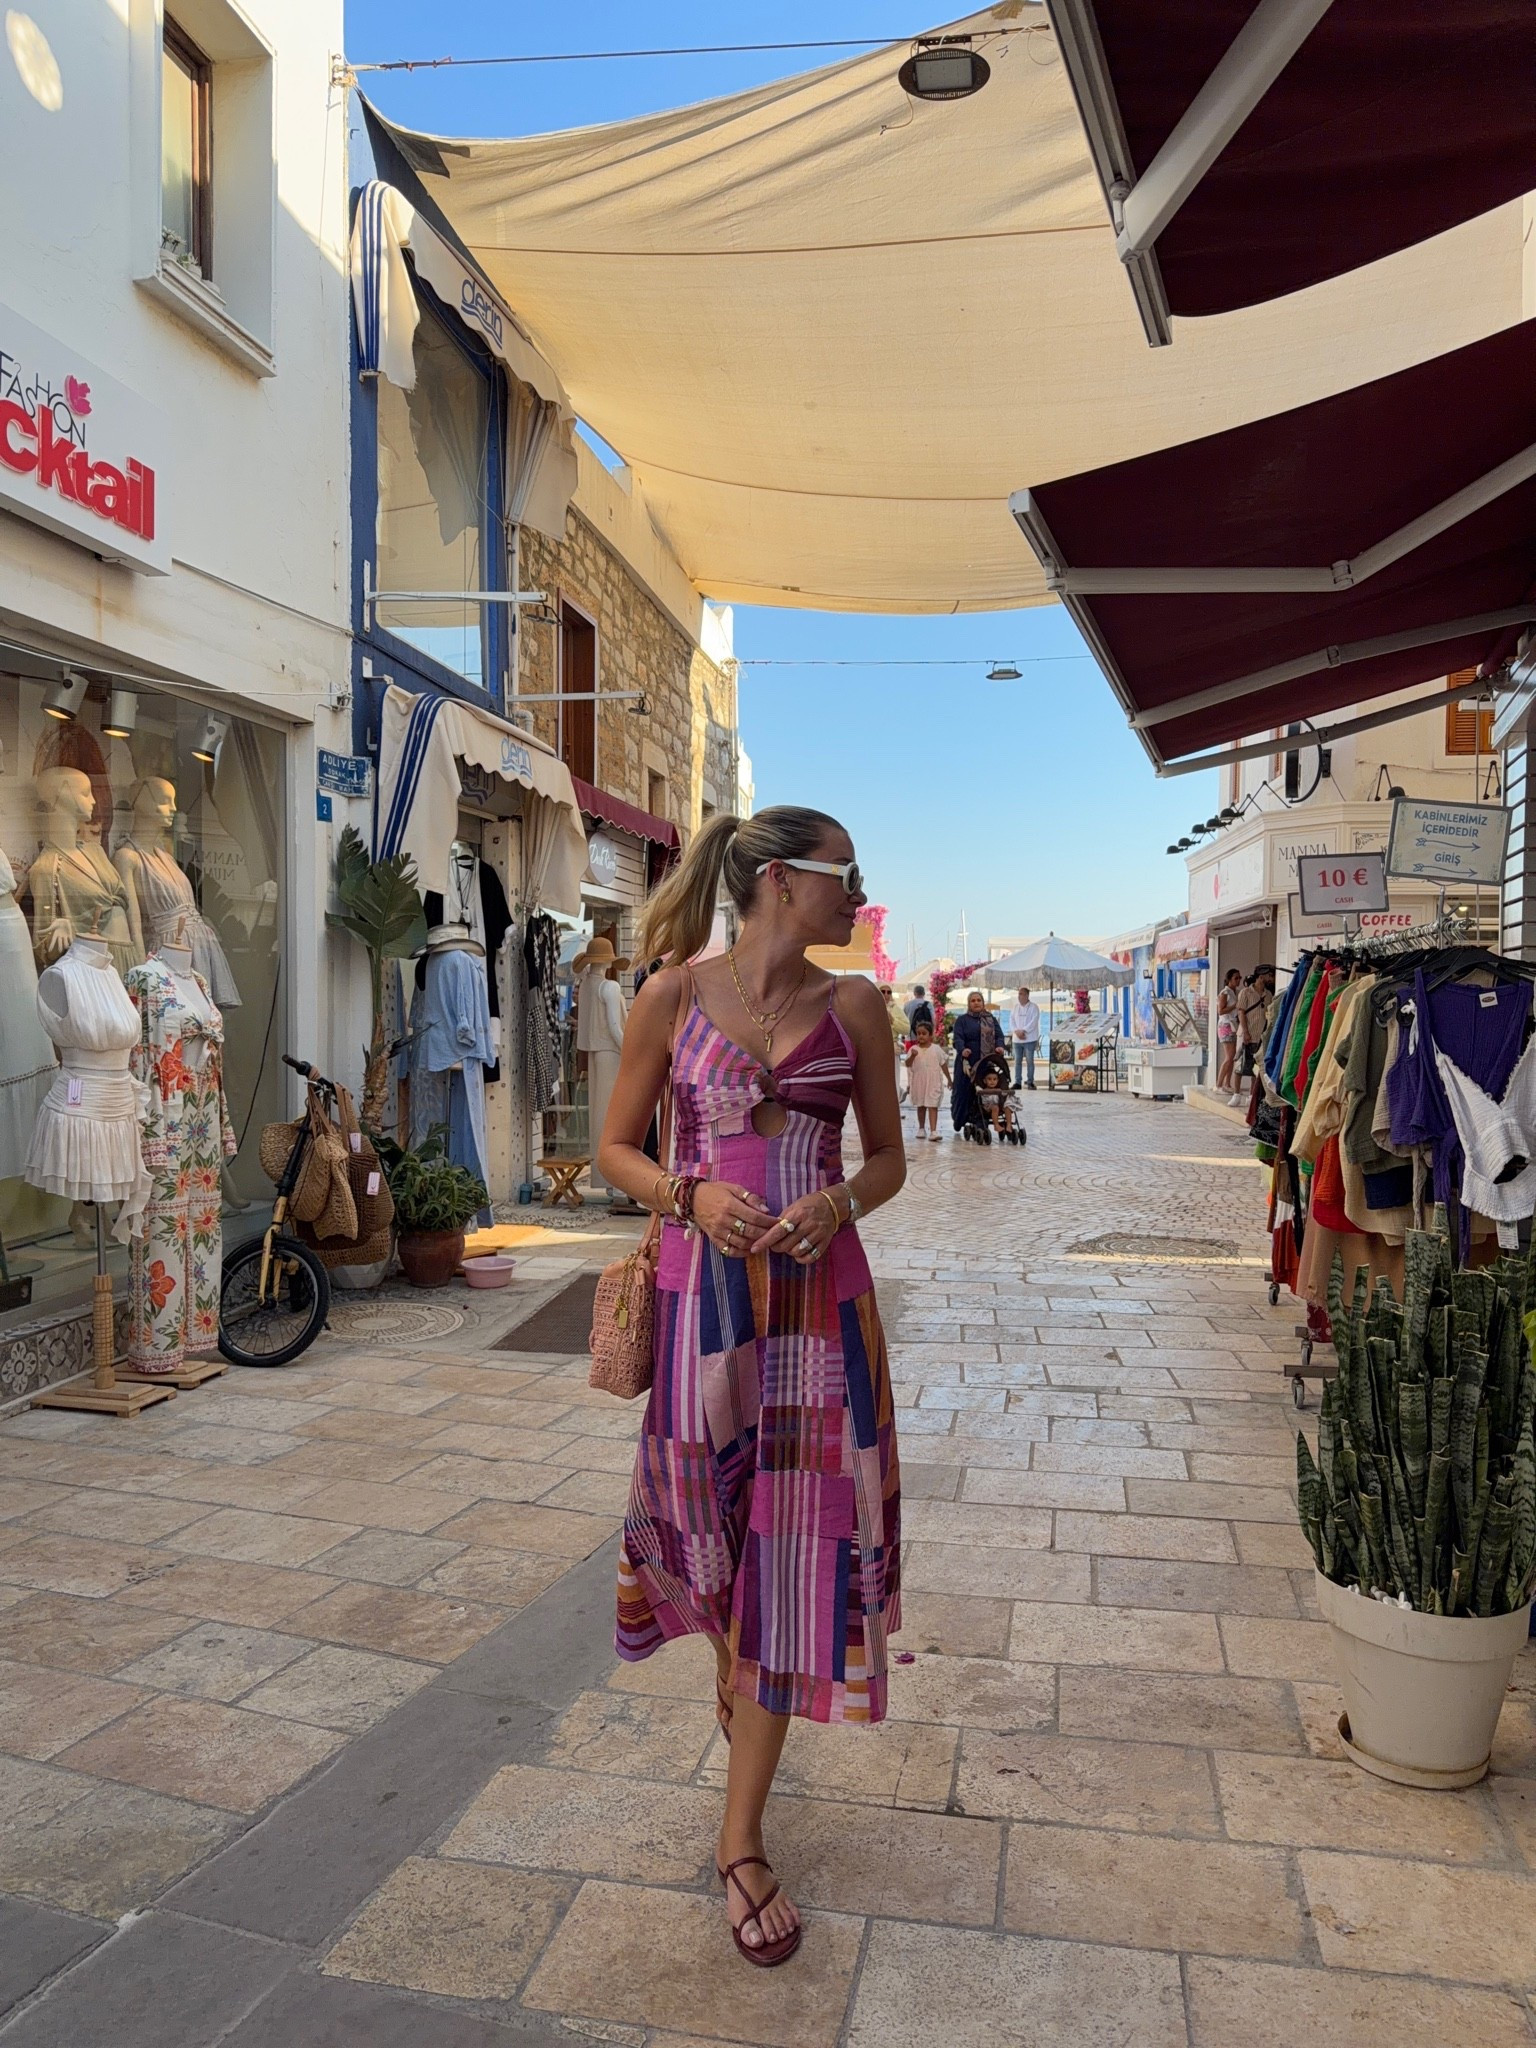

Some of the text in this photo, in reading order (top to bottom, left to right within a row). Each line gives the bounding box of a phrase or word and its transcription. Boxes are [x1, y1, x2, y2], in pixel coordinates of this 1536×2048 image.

[462, 279, 502, 345] derin
[0, 399, 155, 541] cktail
[501, 734, 533, 773] derin
[323, 804, 328, 814] 2
[1414, 809, 1488, 826] KABİNLERİMİZ
[1278, 843, 1328, 860] MAMMA
[1434, 851, 1461, 866] GİRİŞ
[1318, 869, 1346, 888] 10
[1352, 868, 1368, 886] €
[1361, 914, 1412, 926] COFFEE
